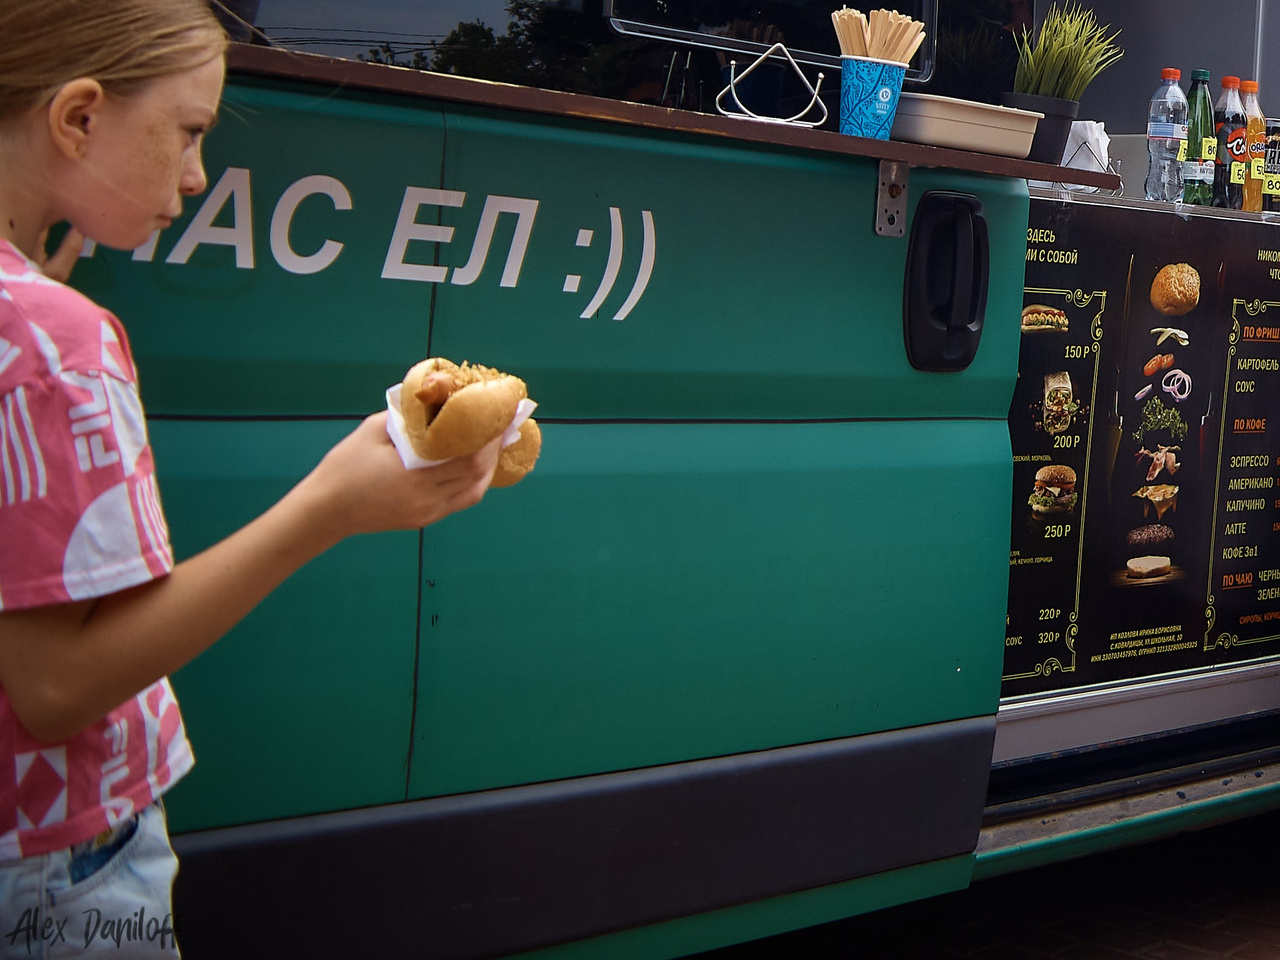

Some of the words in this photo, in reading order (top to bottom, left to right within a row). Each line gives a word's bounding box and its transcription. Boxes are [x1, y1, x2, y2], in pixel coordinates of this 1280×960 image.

[1267, 180, 1280, 190] 80
[1027, 228, 1056, 243] ЗДЕСЬ
[80, 167, 353, 276] АС
[381, 186, 539, 288] ЕЛ
[563, 207, 656, 321] :))
[1039, 249, 1046, 262] С
[1047, 249, 1079, 265] СОБОЙ
[1243, 326, 1255, 339] ПО
[1064, 345, 1082, 358] 150
[1237, 358, 1280, 371] КАРТОФЕЛЬ
[1235, 380, 1255, 393] СОУС
[1234, 418, 1245, 430] ПО
[1245, 418, 1267, 430] КОФЕ
[1053, 435, 1072, 448] 200
[1230, 455, 1270, 468] ЭСПРЕССО
[1228, 476, 1274, 490] АМЕРИКАНО
[1226, 498, 1266, 512] КАПУЧИНО
[1044, 525, 1063, 538] 250
[1224, 522, 1247, 536] ЛАТТЕ
[1222, 546, 1244, 560] КОФЕ
[1244, 545, 1258, 558] 3в1
[1222, 574, 1234, 587] ПО
[1235, 572, 1253, 585] ЧАЮ
[1039, 608, 1055, 620] 220
[1005, 635, 1023, 646] СОУС
[1038, 631, 1054, 644] 320
